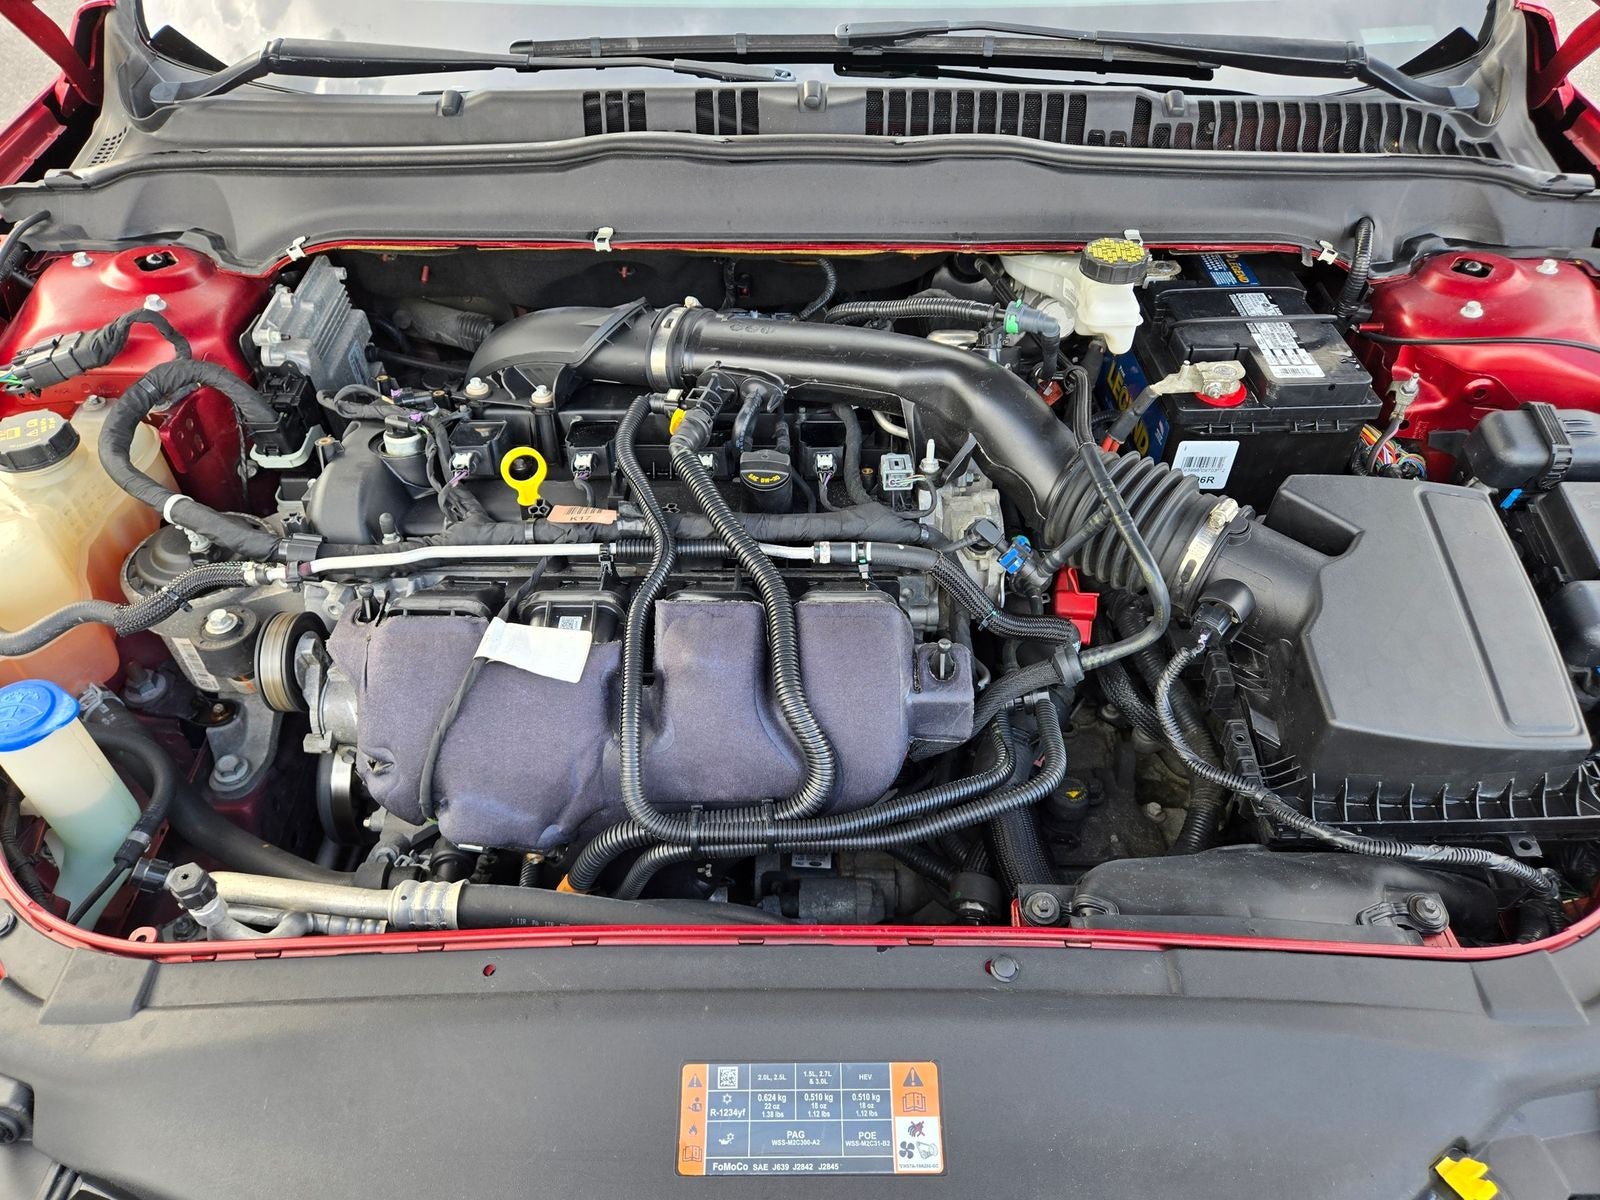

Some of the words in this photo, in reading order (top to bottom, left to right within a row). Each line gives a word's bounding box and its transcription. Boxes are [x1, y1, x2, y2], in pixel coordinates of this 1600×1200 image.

[757, 1073, 772, 1082] 2.0L,
[773, 1073, 787, 1081] 2.5L
[803, 1070, 818, 1078] 1.5L,
[858, 1073, 873, 1081] HEV
[757, 1093, 776, 1102] 0.624
[777, 1093, 787, 1104] kg
[803, 1092, 823, 1102] 0.510
[824, 1092, 834, 1103] kg
[851, 1092, 871, 1102] 0.510
[871, 1092, 881, 1103] kg
[710, 1108, 746, 1119] R-1234yf
[761, 1110, 774, 1118] 1.38
[774, 1110, 785, 1118] lbs
[807, 1110, 820, 1118] 1.12
[821, 1110, 831, 1118] lbs
[786, 1130, 806, 1139] PAG
[858, 1131, 877, 1140] POE
[712, 1161, 749, 1171] FoMoCo
[752, 1163, 769, 1171] SAE
[772, 1163, 790, 1171] J639
[792, 1163, 814, 1171] J2842
[818, 1162, 840, 1171] J2845
